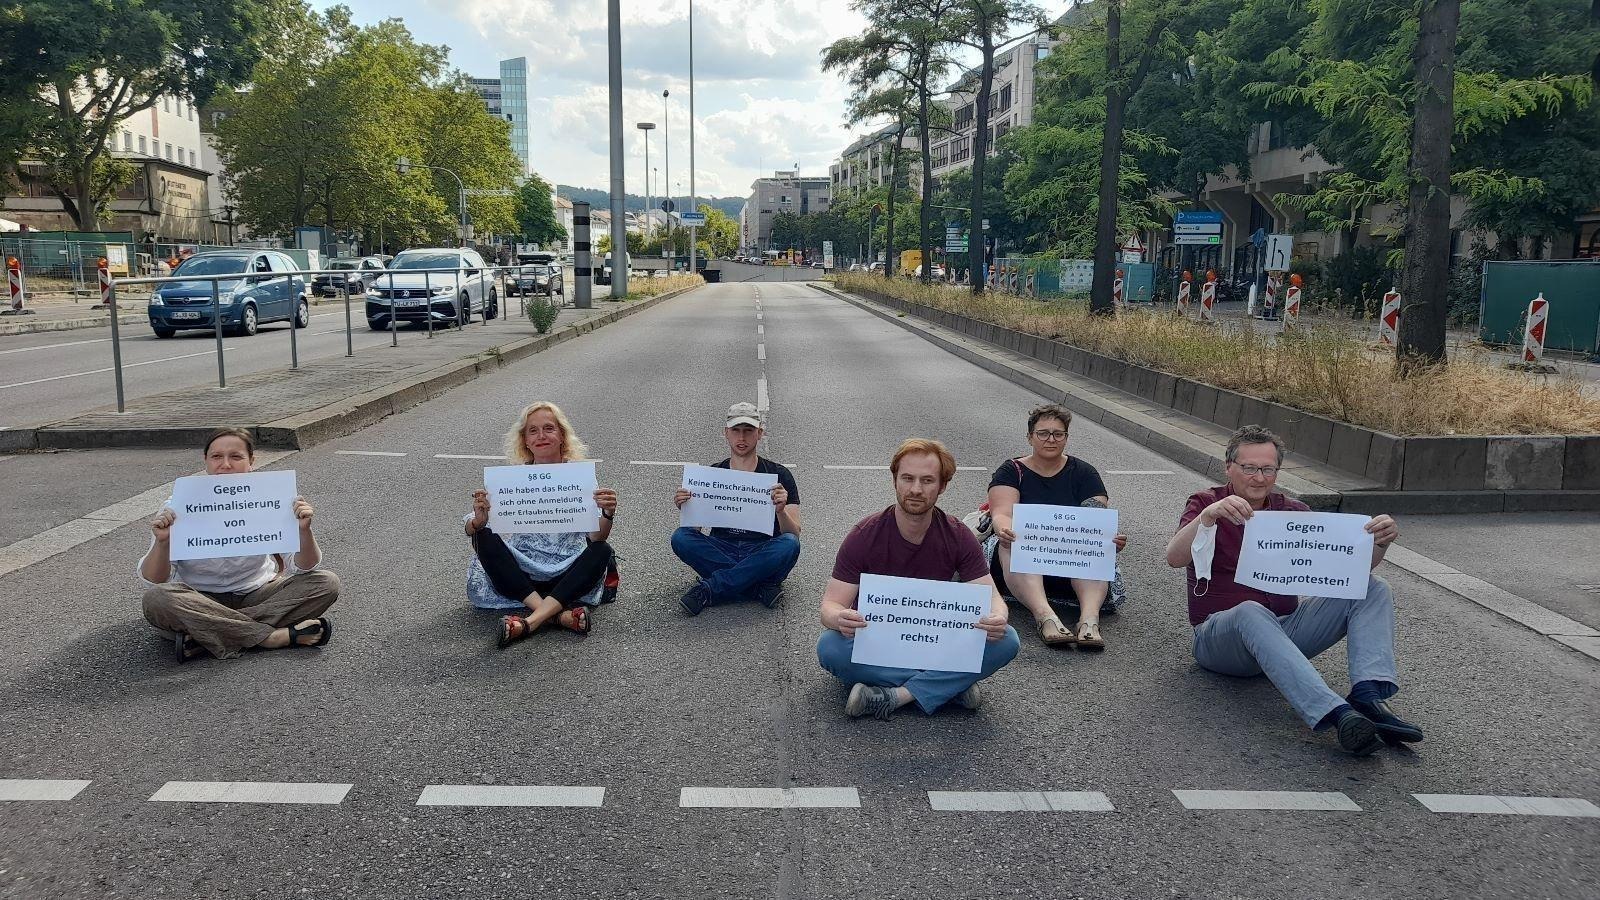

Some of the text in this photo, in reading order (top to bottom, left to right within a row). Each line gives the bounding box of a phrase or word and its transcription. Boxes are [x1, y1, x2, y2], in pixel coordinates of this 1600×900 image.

[528, 472, 552, 481] §8 GG
[213, 485, 251, 495] Gegen
[515, 486, 540, 494] haben
[541, 485, 556, 493] das
[557, 484, 582, 492] Recht,
[687, 478, 771, 496] Keine Einschränkung
[538, 496, 583, 504] Anmeldung
[703, 492, 770, 506] Demonstrations-
[185, 499, 281, 513] Kriminalisierung
[497, 506, 587, 517] oder Erlaubnis friedlich
[714, 505, 742, 513] rechts!
[523, 517, 574, 525] versammeln!
[1053, 513, 1076, 521] §8 GG
[223, 519, 246, 528] von
[1286, 521, 1325, 534] Gegen
[1040, 524, 1064, 532] haben
[1080, 527, 1104, 536] Recht,
[187, 531, 283, 547] Klimaprotesten!
[1023, 533, 1038, 541] sich
[1060, 536, 1103, 547] Anmeldung
[1039, 546, 1073, 555] Erlaubnis
[1074, 549, 1105, 558] friedlich
[1257, 539, 1354, 555] Kriminalisierung
[1043, 558, 1091, 568] versammeln!
[1290, 558, 1312, 566] von
[1252, 571, 1350, 587] Klimaprotesten!
[867, 593, 982, 615] Keine Einschränkung
[864, 613, 884, 623] des
[900, 633, 939, 644] rechts!
